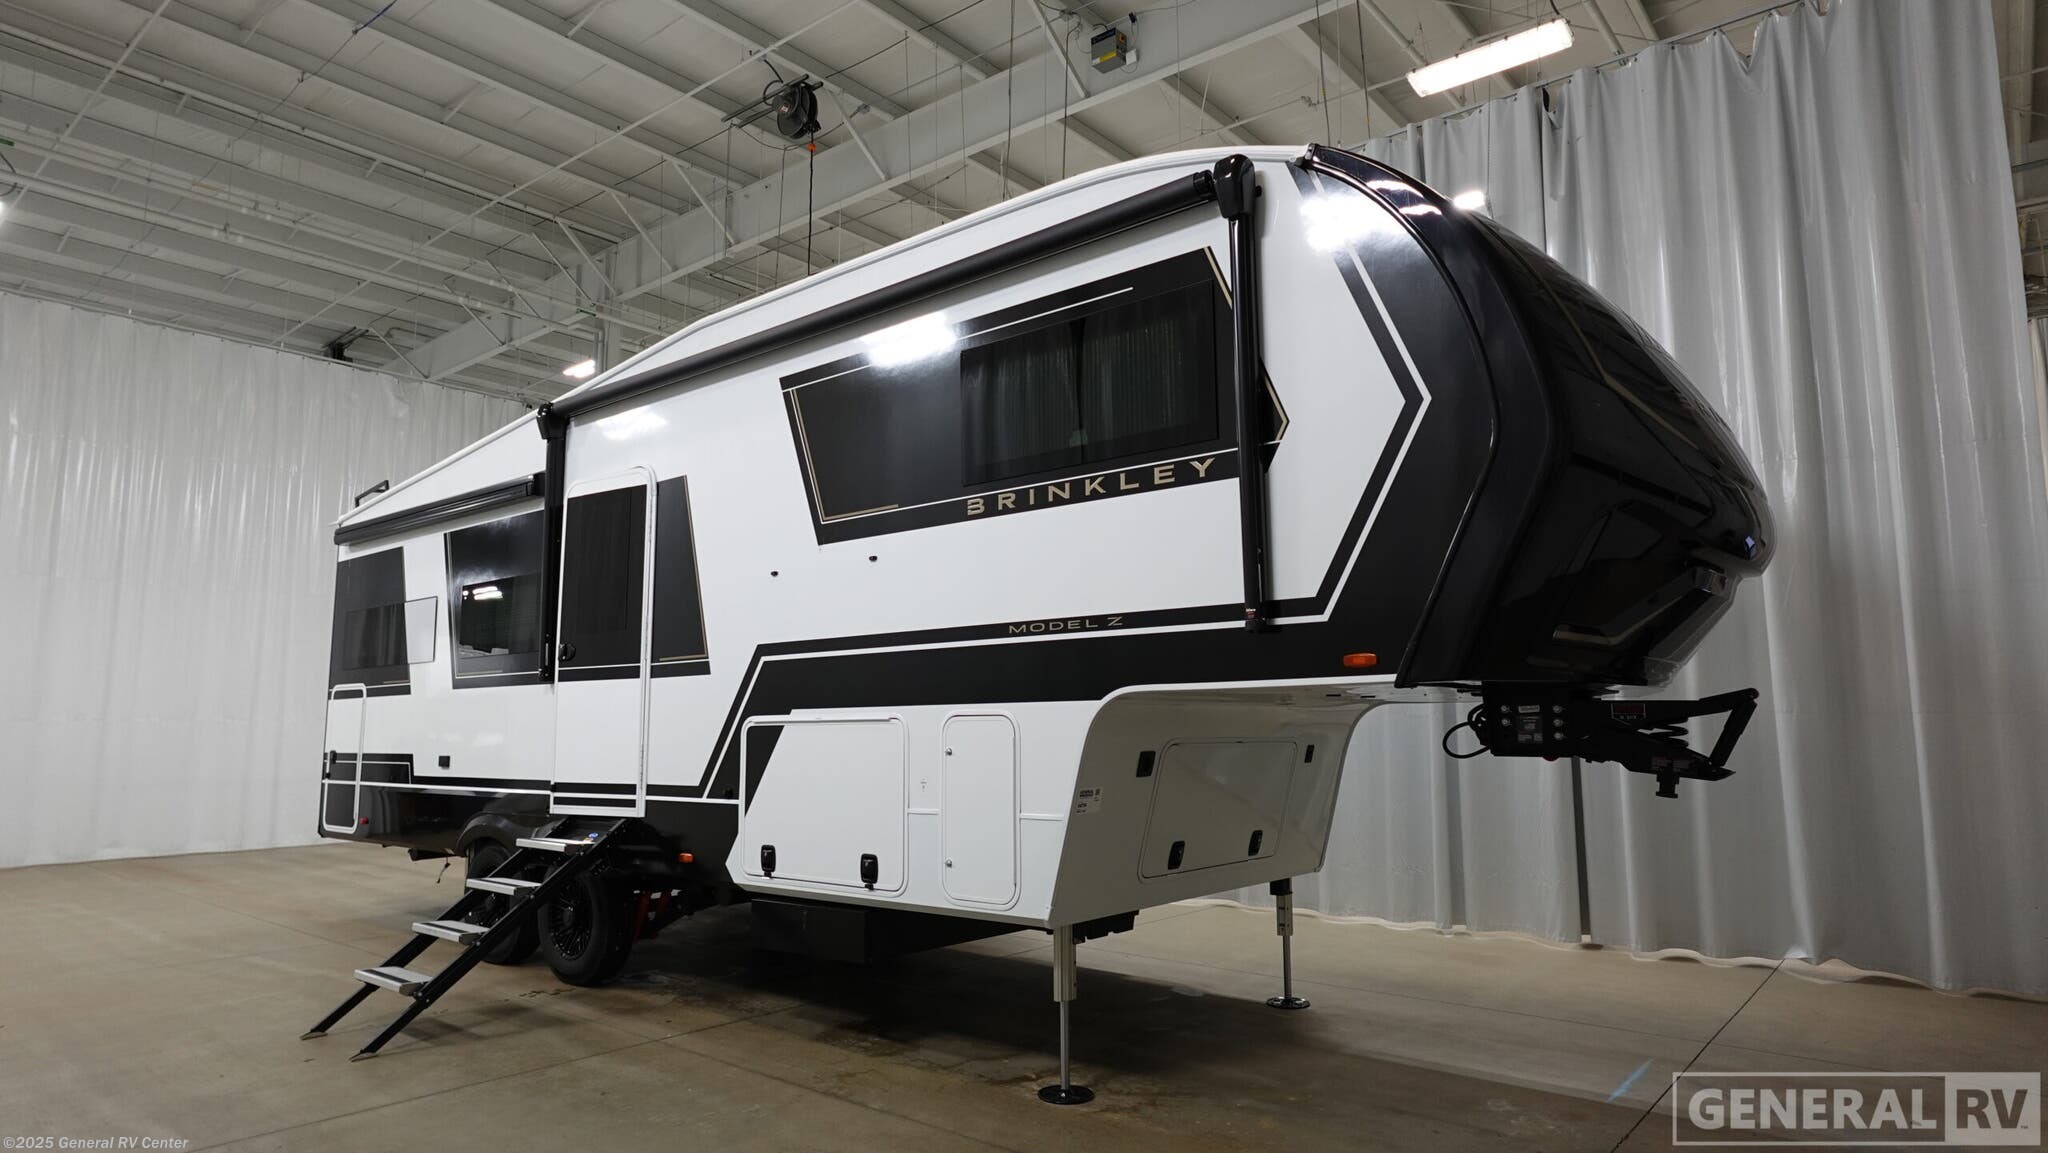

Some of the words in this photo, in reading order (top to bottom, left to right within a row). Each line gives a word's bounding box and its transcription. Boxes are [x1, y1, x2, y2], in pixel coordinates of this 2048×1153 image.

[967, 457, 1215, 516] BRINKLEY
[1008, 619, 1098, 634] MODEL
[1107, 616, 1123, 627] Z
